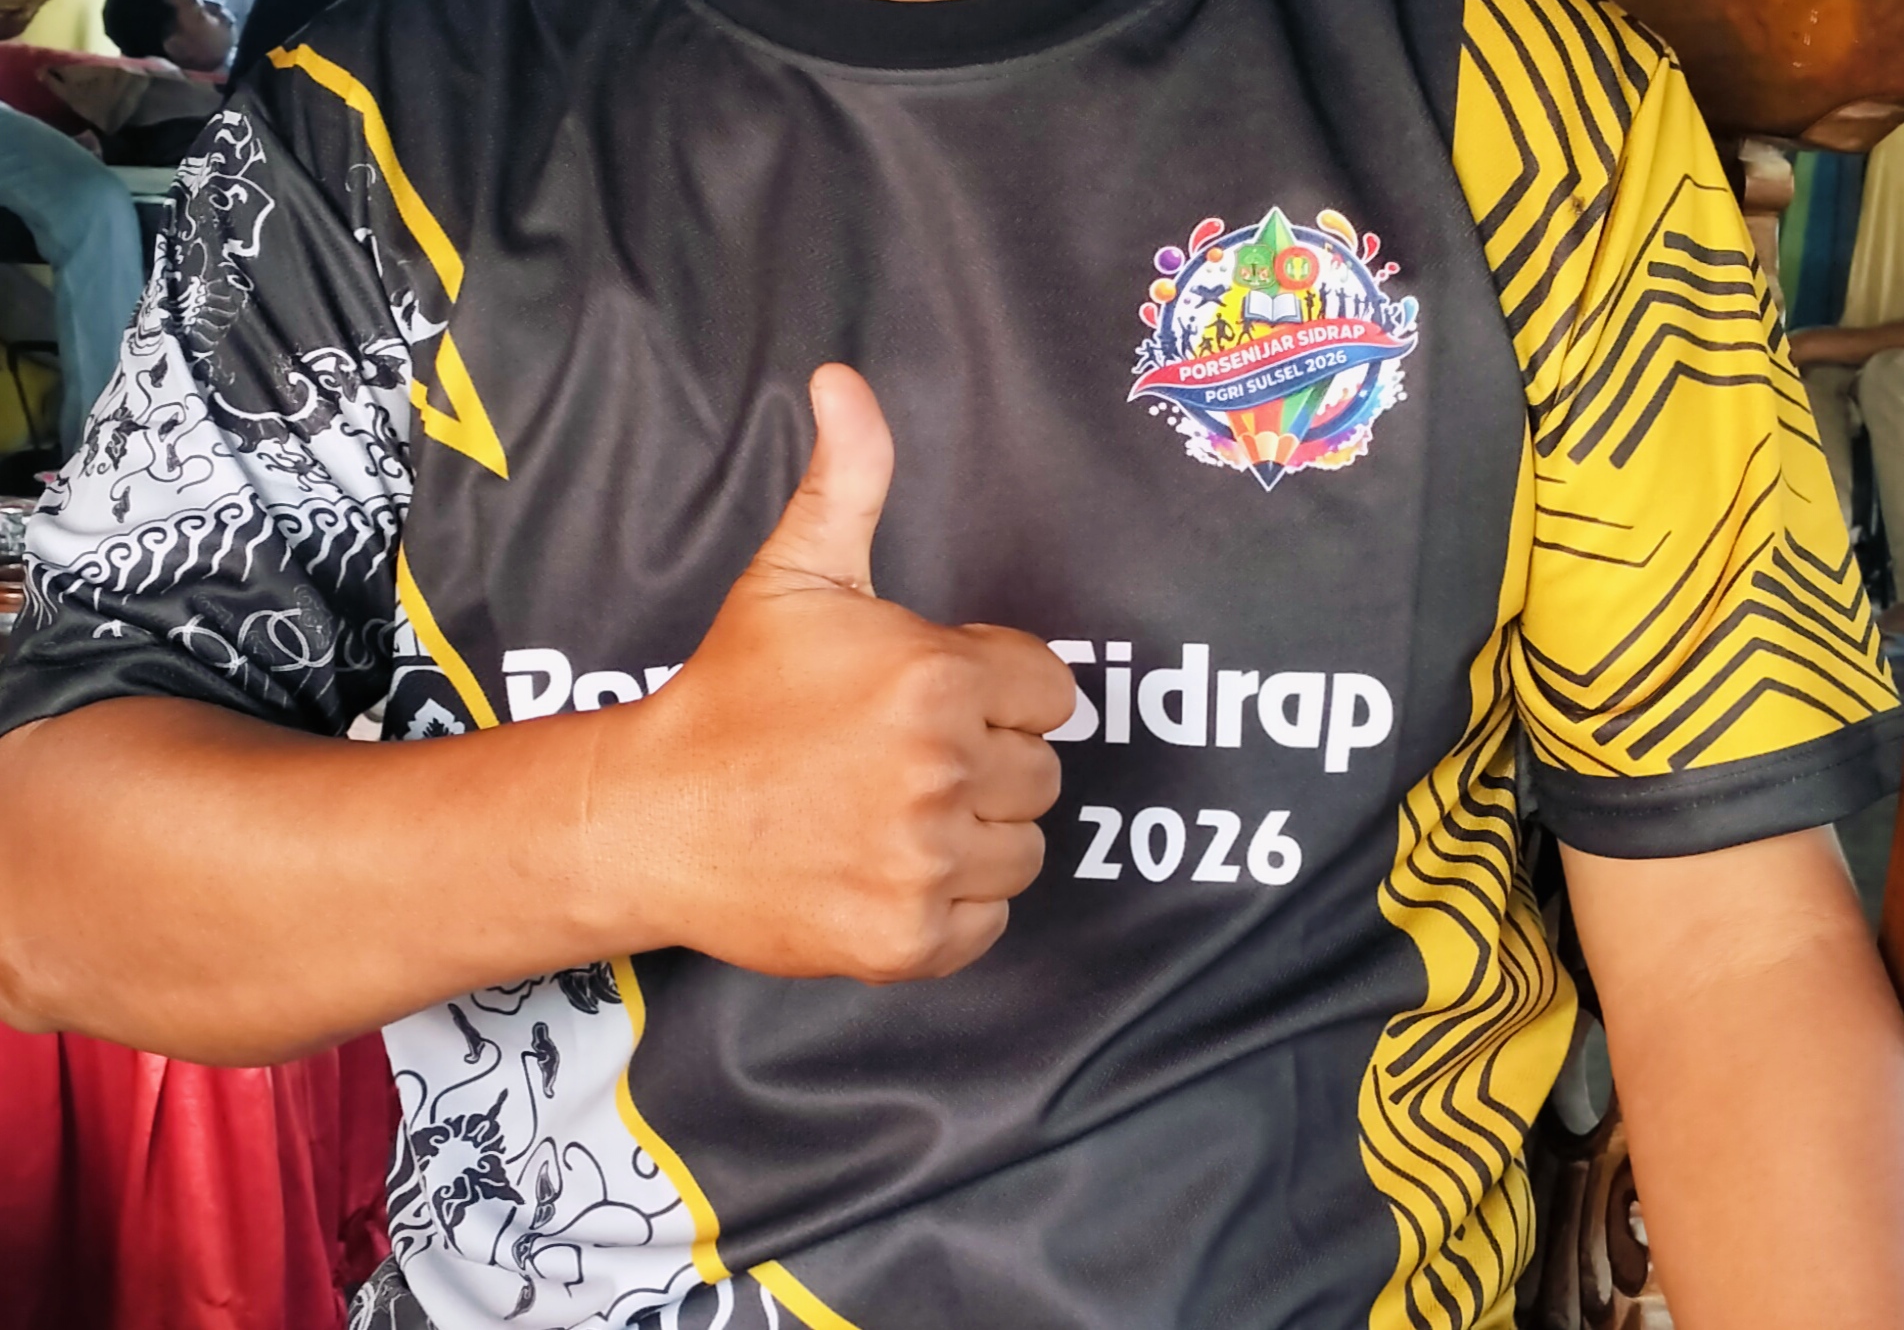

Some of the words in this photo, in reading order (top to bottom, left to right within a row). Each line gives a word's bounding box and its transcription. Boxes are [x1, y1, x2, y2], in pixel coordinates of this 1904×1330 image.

[1178, 334, 1295, 382] PORSENIJAR
[1296, 323, 1366, 347] SIDRAP
[1204, 384, 1244, 403] PGRI
[1247, 363, 1304, 394] SULSEL
[1305, 350, 1348, 374] 2026
[1042, 639, 1394, 773] Sidrap
[1073, 805, 1303, 886] 2026
